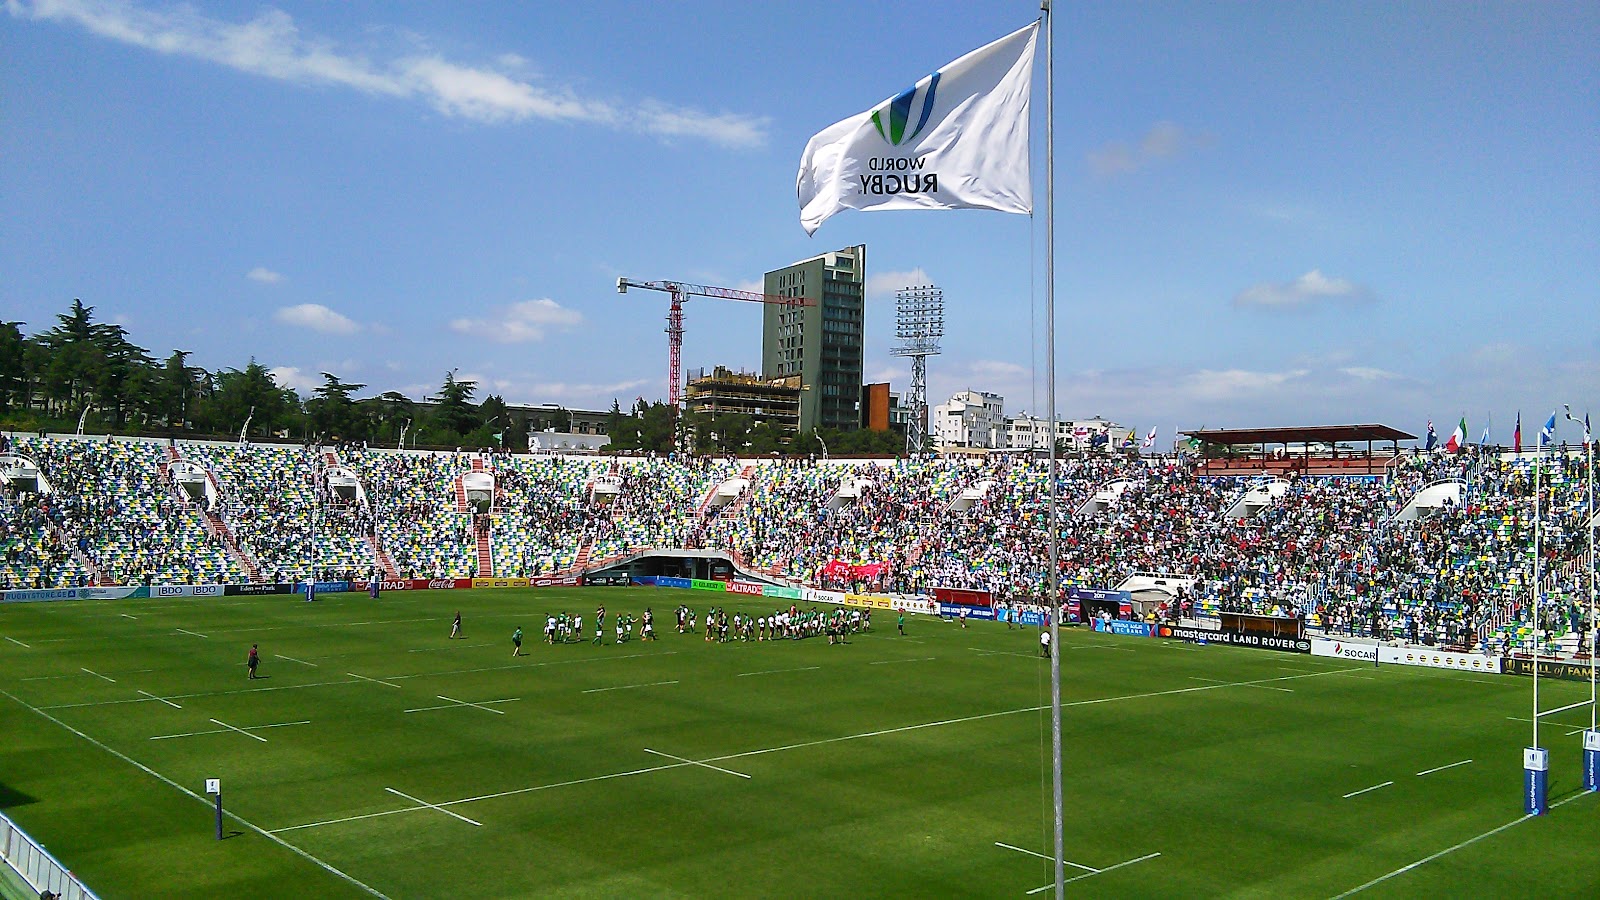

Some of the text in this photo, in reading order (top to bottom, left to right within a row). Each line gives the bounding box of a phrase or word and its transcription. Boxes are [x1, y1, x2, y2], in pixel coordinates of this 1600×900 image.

[161, 586, 183, 595] BDO
[195, 585, 216, 594] BDO
[364, 581, 405, 591] ATRAD
[731, 584, 758, 594] ALTRAD
[1173, 628, 1230, 642] mastercard
[1233, 634, 1295, 649] LAND ROVER
[1344, 649, 1376, 660] SOCAR
